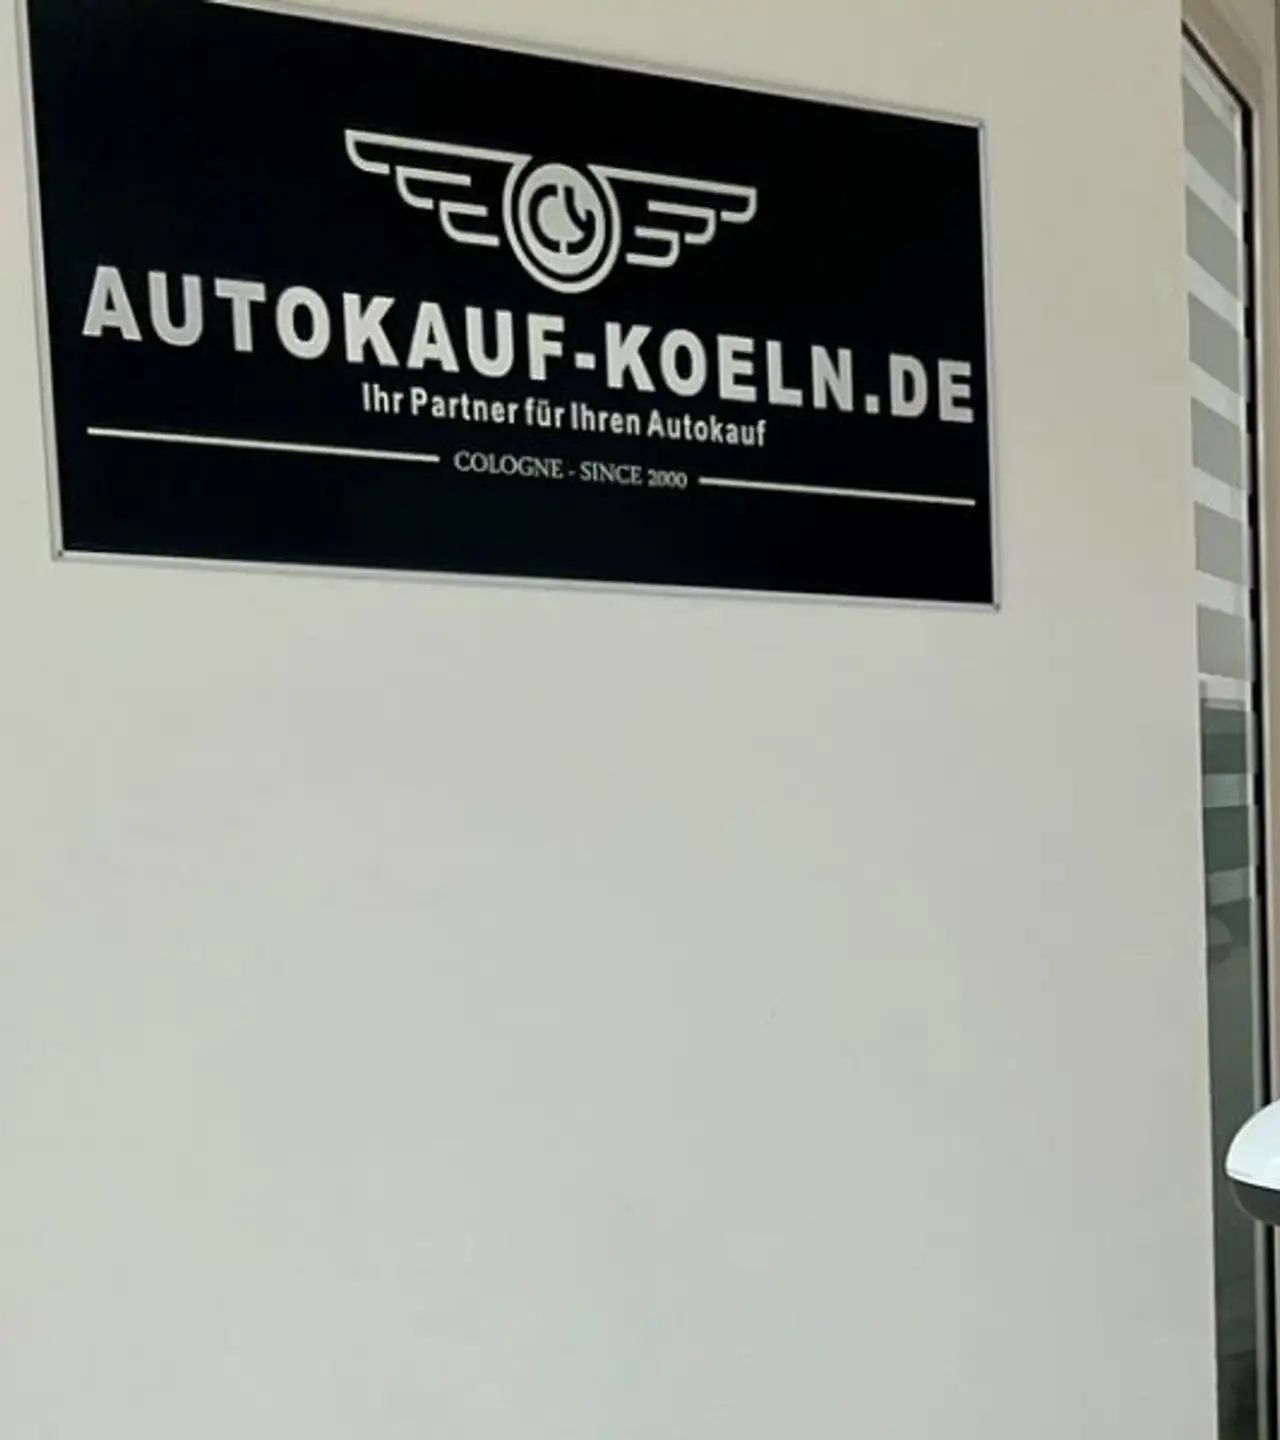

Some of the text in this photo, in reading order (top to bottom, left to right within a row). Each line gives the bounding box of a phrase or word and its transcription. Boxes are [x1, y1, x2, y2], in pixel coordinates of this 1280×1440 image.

[83, 265, 976, 424] AUTOKAUF-KOELN.DE
[361, 382, 767, 447] Ihr Partner für Ihren Autokauf
[453, 450, 563, 479] COLOGNE
[580, 461, 642, 485] SINCE
[648, 469, 688, 489] 2000
